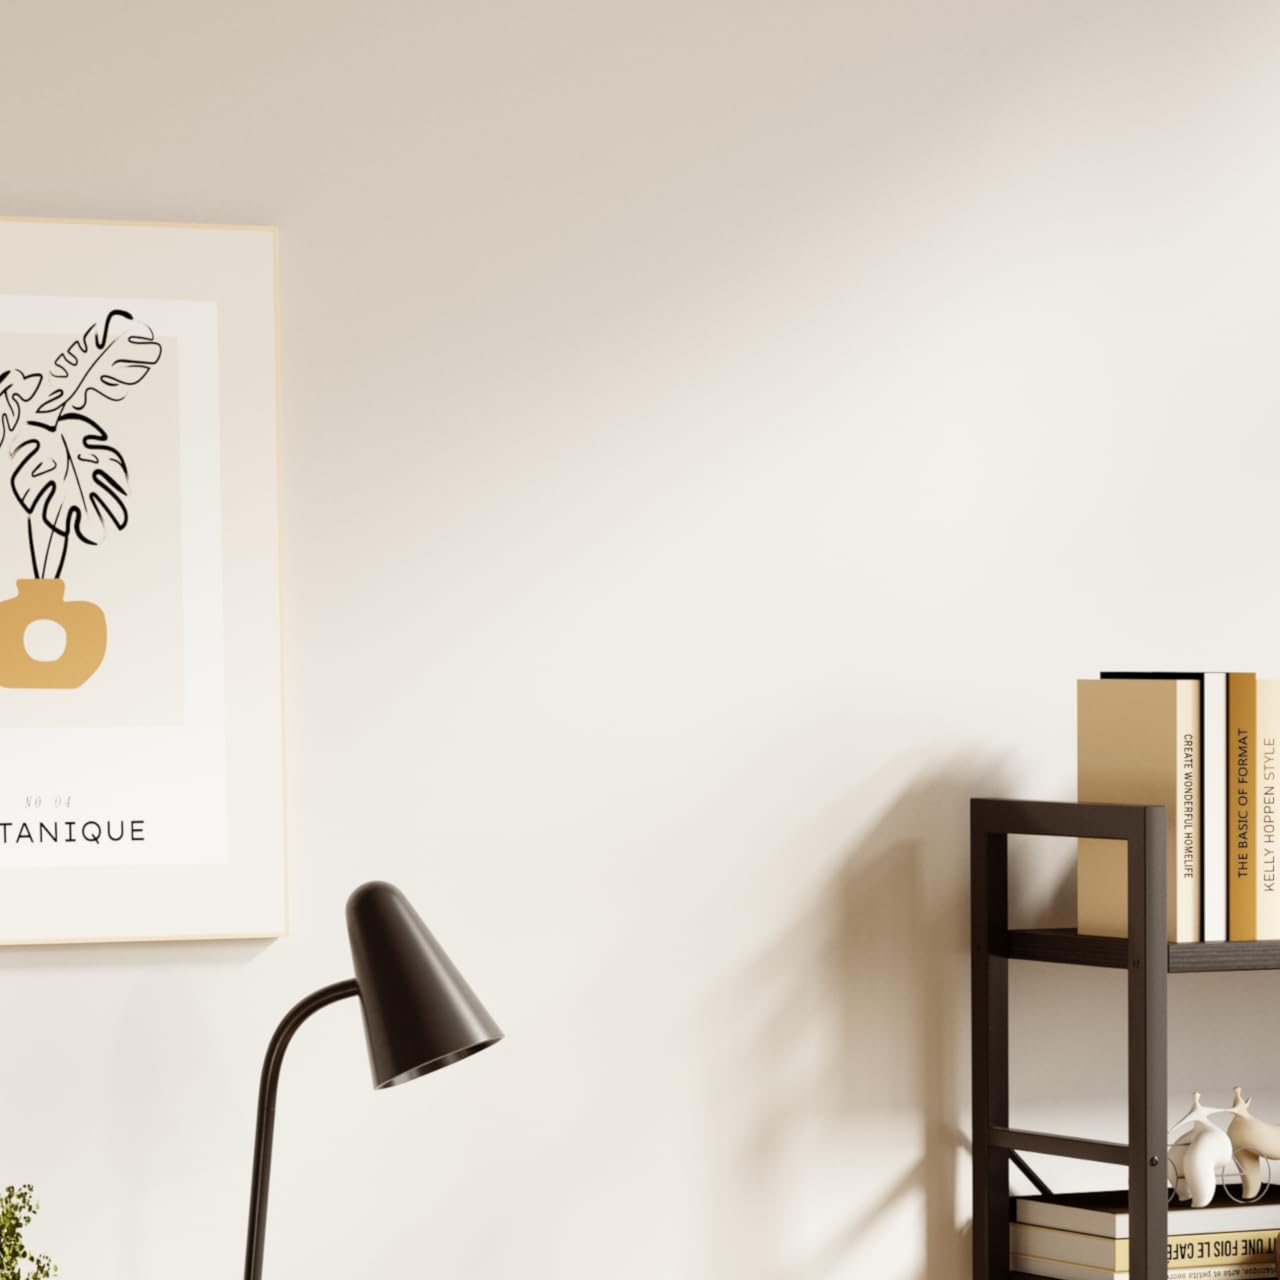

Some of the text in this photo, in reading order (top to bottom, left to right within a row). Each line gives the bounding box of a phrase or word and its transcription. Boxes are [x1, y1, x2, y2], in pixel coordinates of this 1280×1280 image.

[1183, 733, 1193, 879] CREATE WONDERFUL HOMELIFE
[1238, 728, 1248, 878] THE BASIC OF FORMAT
[1264, 738, 1275, 892] KELLY HOPPEN STYLE
[0, 820, 145, 844] TANIQUE
[1197, 1242, 1210, 1258] LE
[1214, 1240, 1238, 1258] FOIS
[1241, 1238, 1264, 1255] UNE
